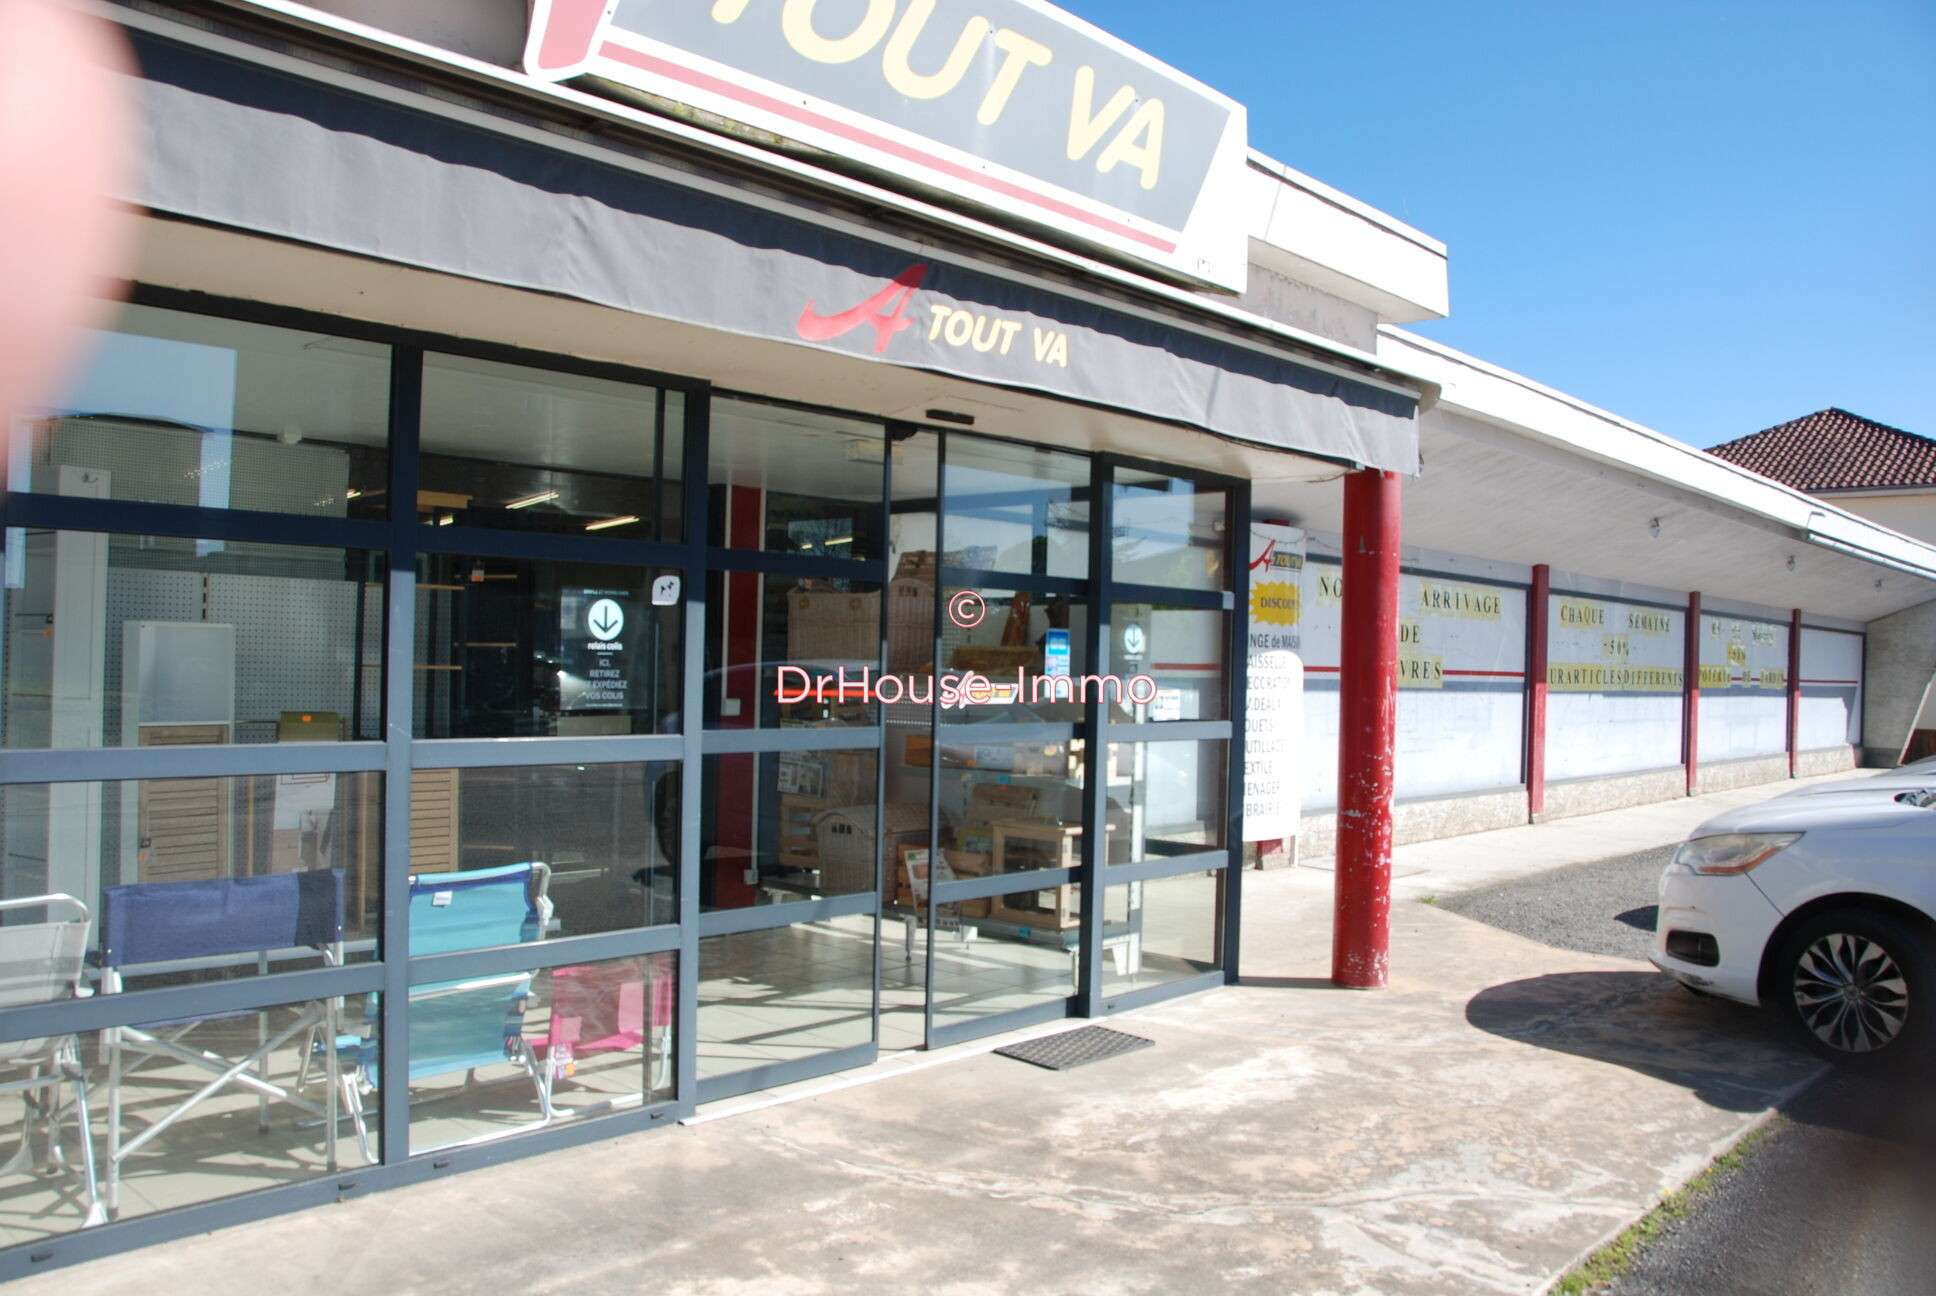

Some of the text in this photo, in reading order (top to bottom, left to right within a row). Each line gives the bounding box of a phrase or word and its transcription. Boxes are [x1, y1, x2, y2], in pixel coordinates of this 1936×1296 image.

[1066, 65, 1165, 190] VA
[928, 304, 1022, 355] TOUT
[1033, 327, 1068, 368] VA
[1421, 588, 1500, 615] ARRIVAGE
[1249, 633, 1269, 649] NGE
[1400, 624, 1420, 644] DE
[1400, 659, 1442, 681] VRES
